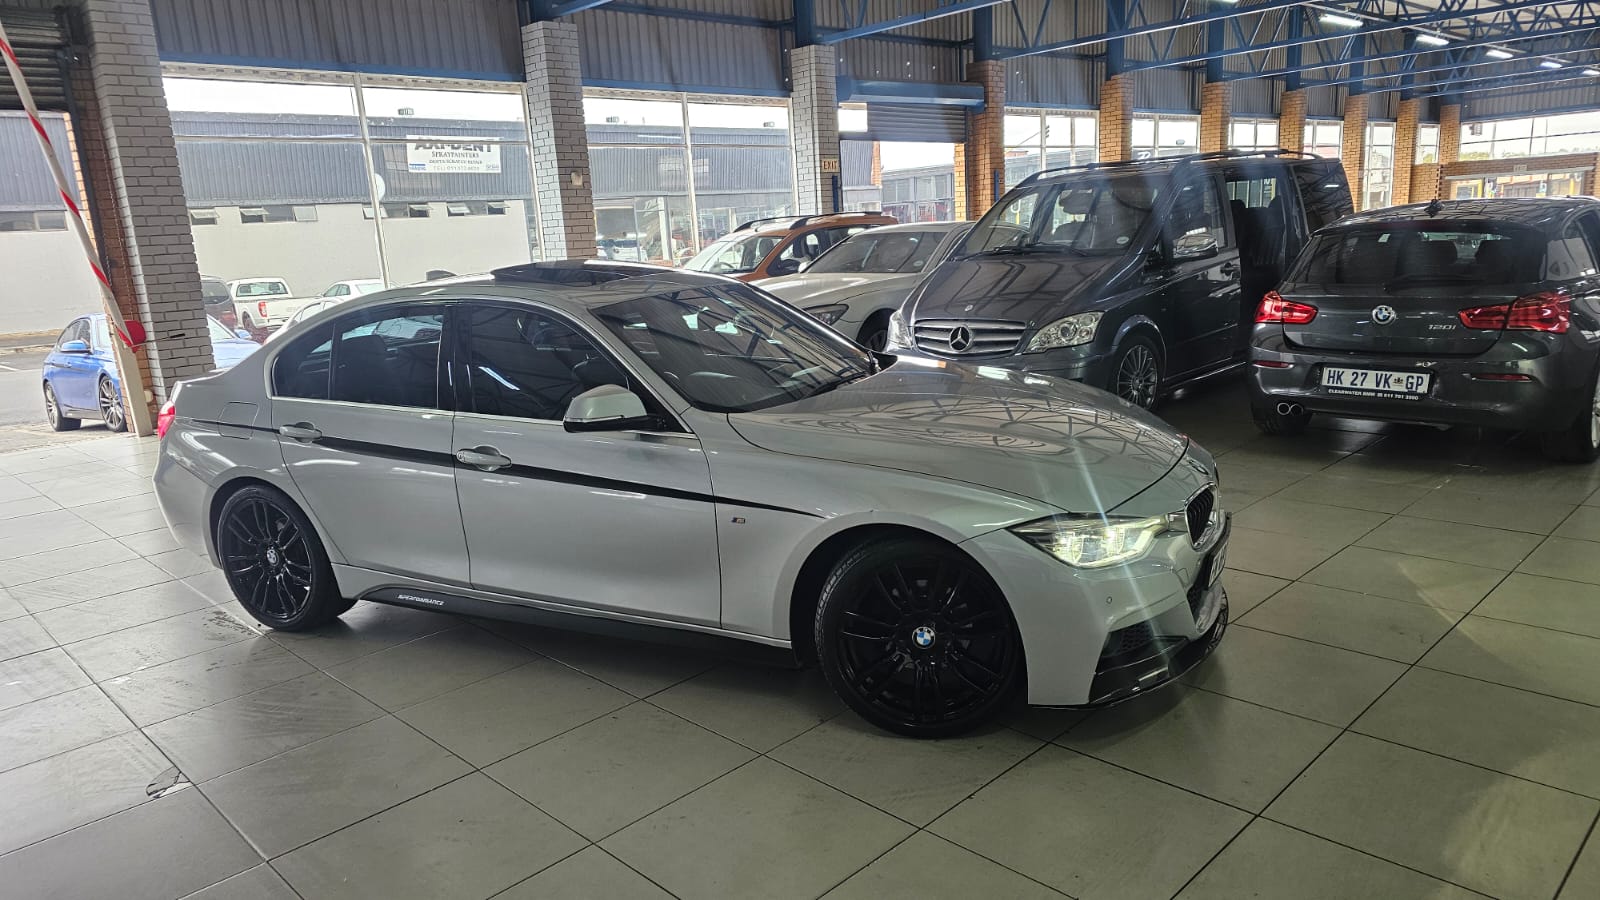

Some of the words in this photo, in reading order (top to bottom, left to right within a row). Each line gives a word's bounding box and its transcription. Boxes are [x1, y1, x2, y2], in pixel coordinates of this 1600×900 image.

[823, 160, 837, 170] EXIT
[1327, 370, 1344, 385] HK
[1350, 371, 1368, 387] 27
[1375, 372, 1393, 389] VK
[1405, 375, 1424, 392] GP
[1328, 388, 1362, 396] CLEARWATER
